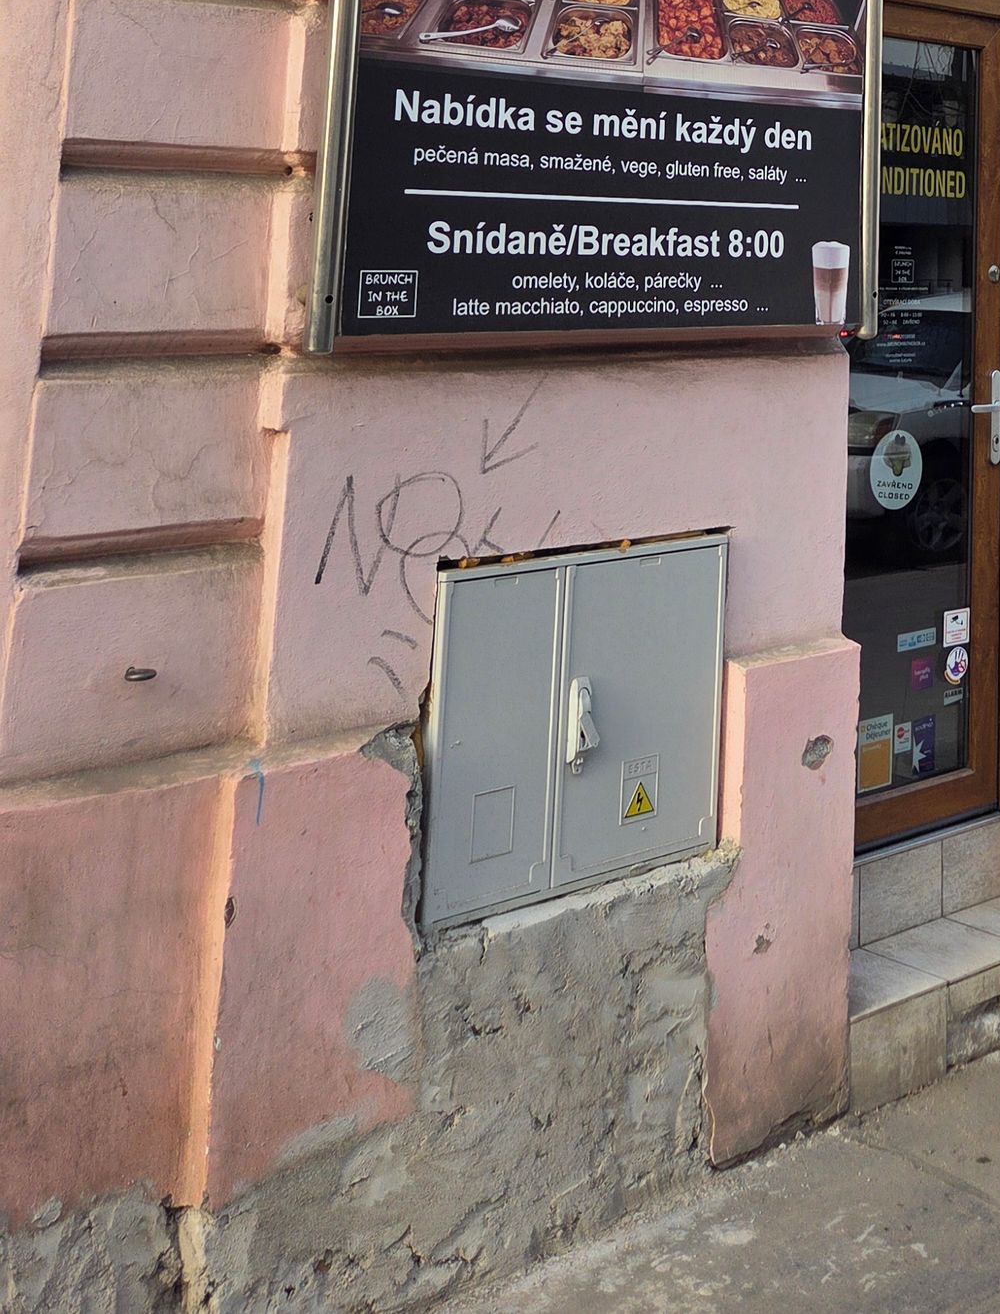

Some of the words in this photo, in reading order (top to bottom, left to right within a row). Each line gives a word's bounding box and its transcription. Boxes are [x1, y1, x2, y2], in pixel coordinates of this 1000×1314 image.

[394, 88, 536, 132] Nabídka
[546, 108, 583, 135] se
[593, 107, 666, 141] mění
[675, 111, 757, 154] každý
[764, 123, 813, 151] den
[413, 145, 479, 166] pečená
[483, 151, 535, 170] masa,
[540, 153, 616, 175] smažené,
[620, 161, 662, 178] vege,
[665, 159, 710, 182] gluten
[713, 162, 744, 182] free,
[748, 163, 788, 185] saláty
[882, 166, 966, 199] NDITIONED
[426, 219, 720, 258] Snídaně/Breakfast
[728, 229, 785, 259] 8:00
[365, 273, 413, 285] BRUNCH
[512, 272, 581, 292] omelety,
[584, 271, 640, 291] koláče,
[644, 271, 702, 294] párečky
[367, 291, 382, 302] IN
[385, 290, 409, 302] THE
[375, 305, 399, 316] BOX
[453, 297, 490, 317] latte
[495, 297, 585, 318] macchiato,
[589, 298, 680, 322] cappuccino,
[683, 299, 748, 320] espresso
[876, 480, 914, 490] ZAVŘENO
[878, 491, 910, 501] CLOSED
